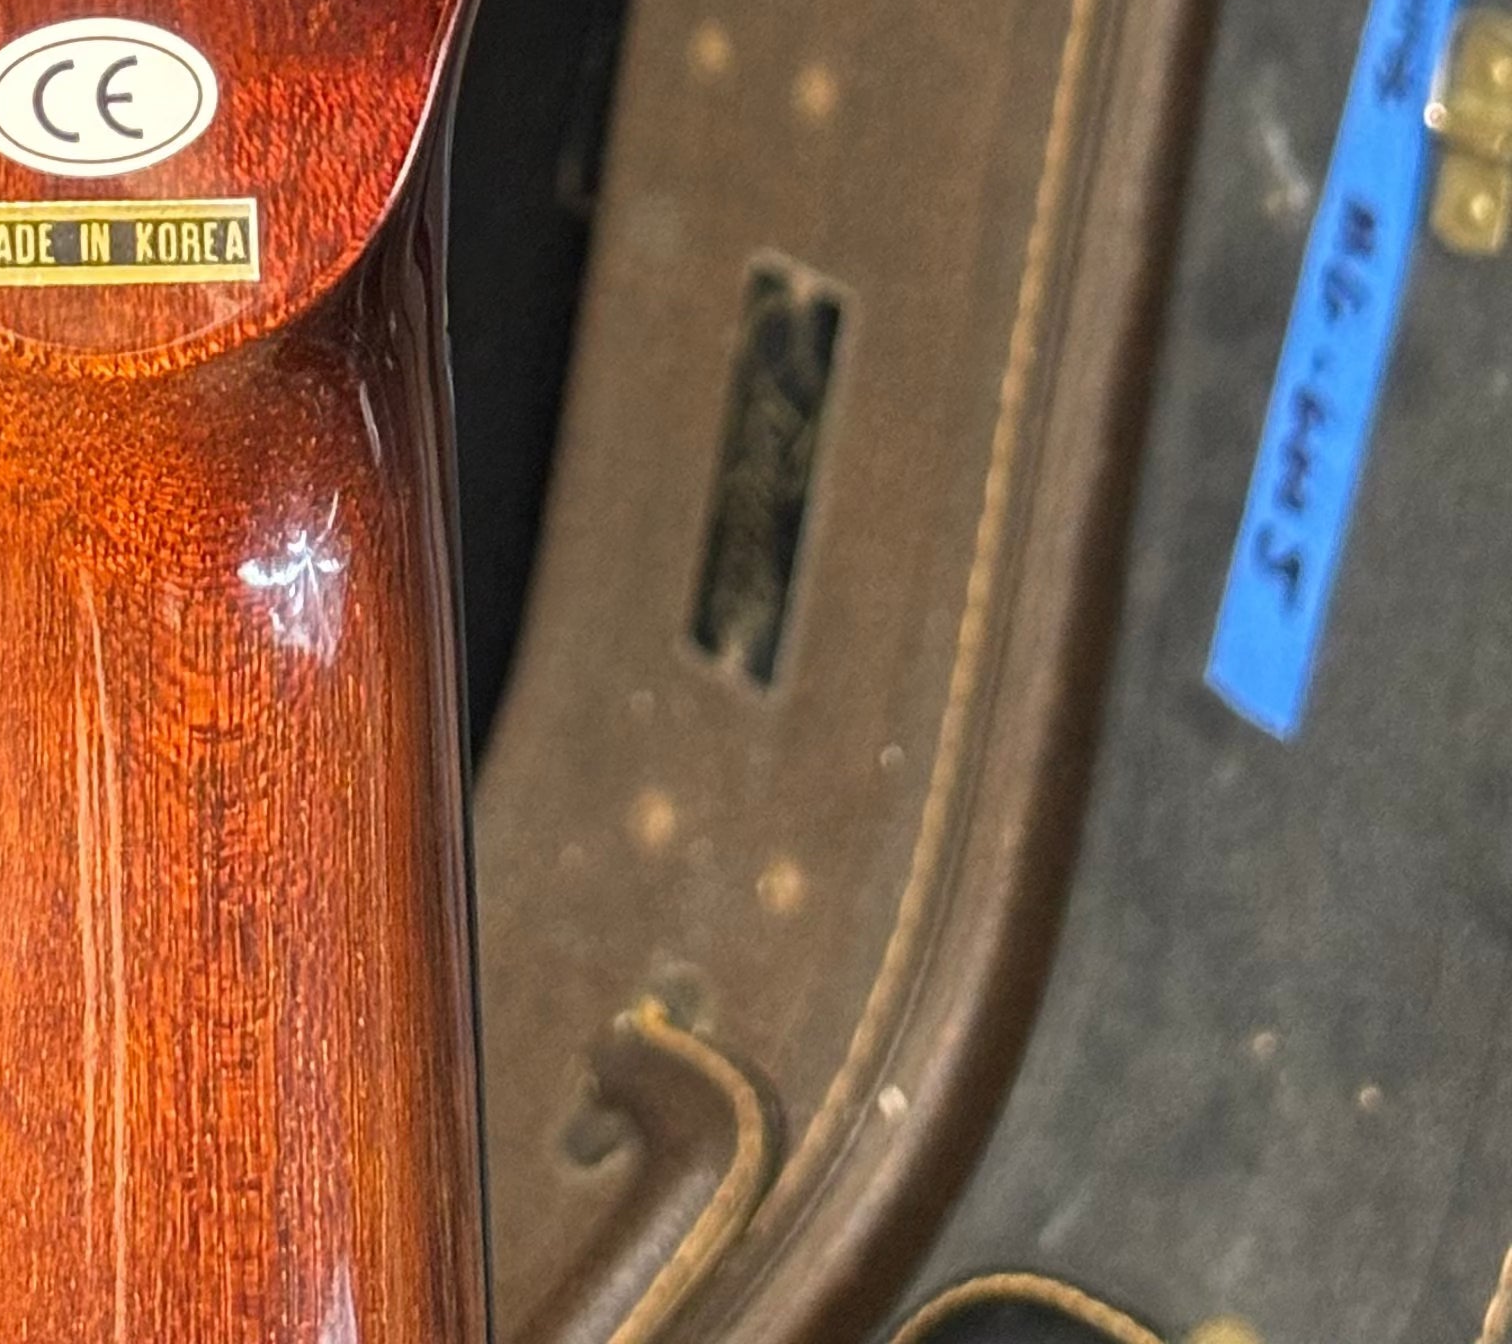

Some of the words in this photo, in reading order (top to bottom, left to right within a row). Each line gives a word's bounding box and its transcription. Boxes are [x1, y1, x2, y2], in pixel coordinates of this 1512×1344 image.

[32, 54, 144, 143] CE
[79, 221, 111, 264] IN
[135, 220, 247, 263] KOREA
